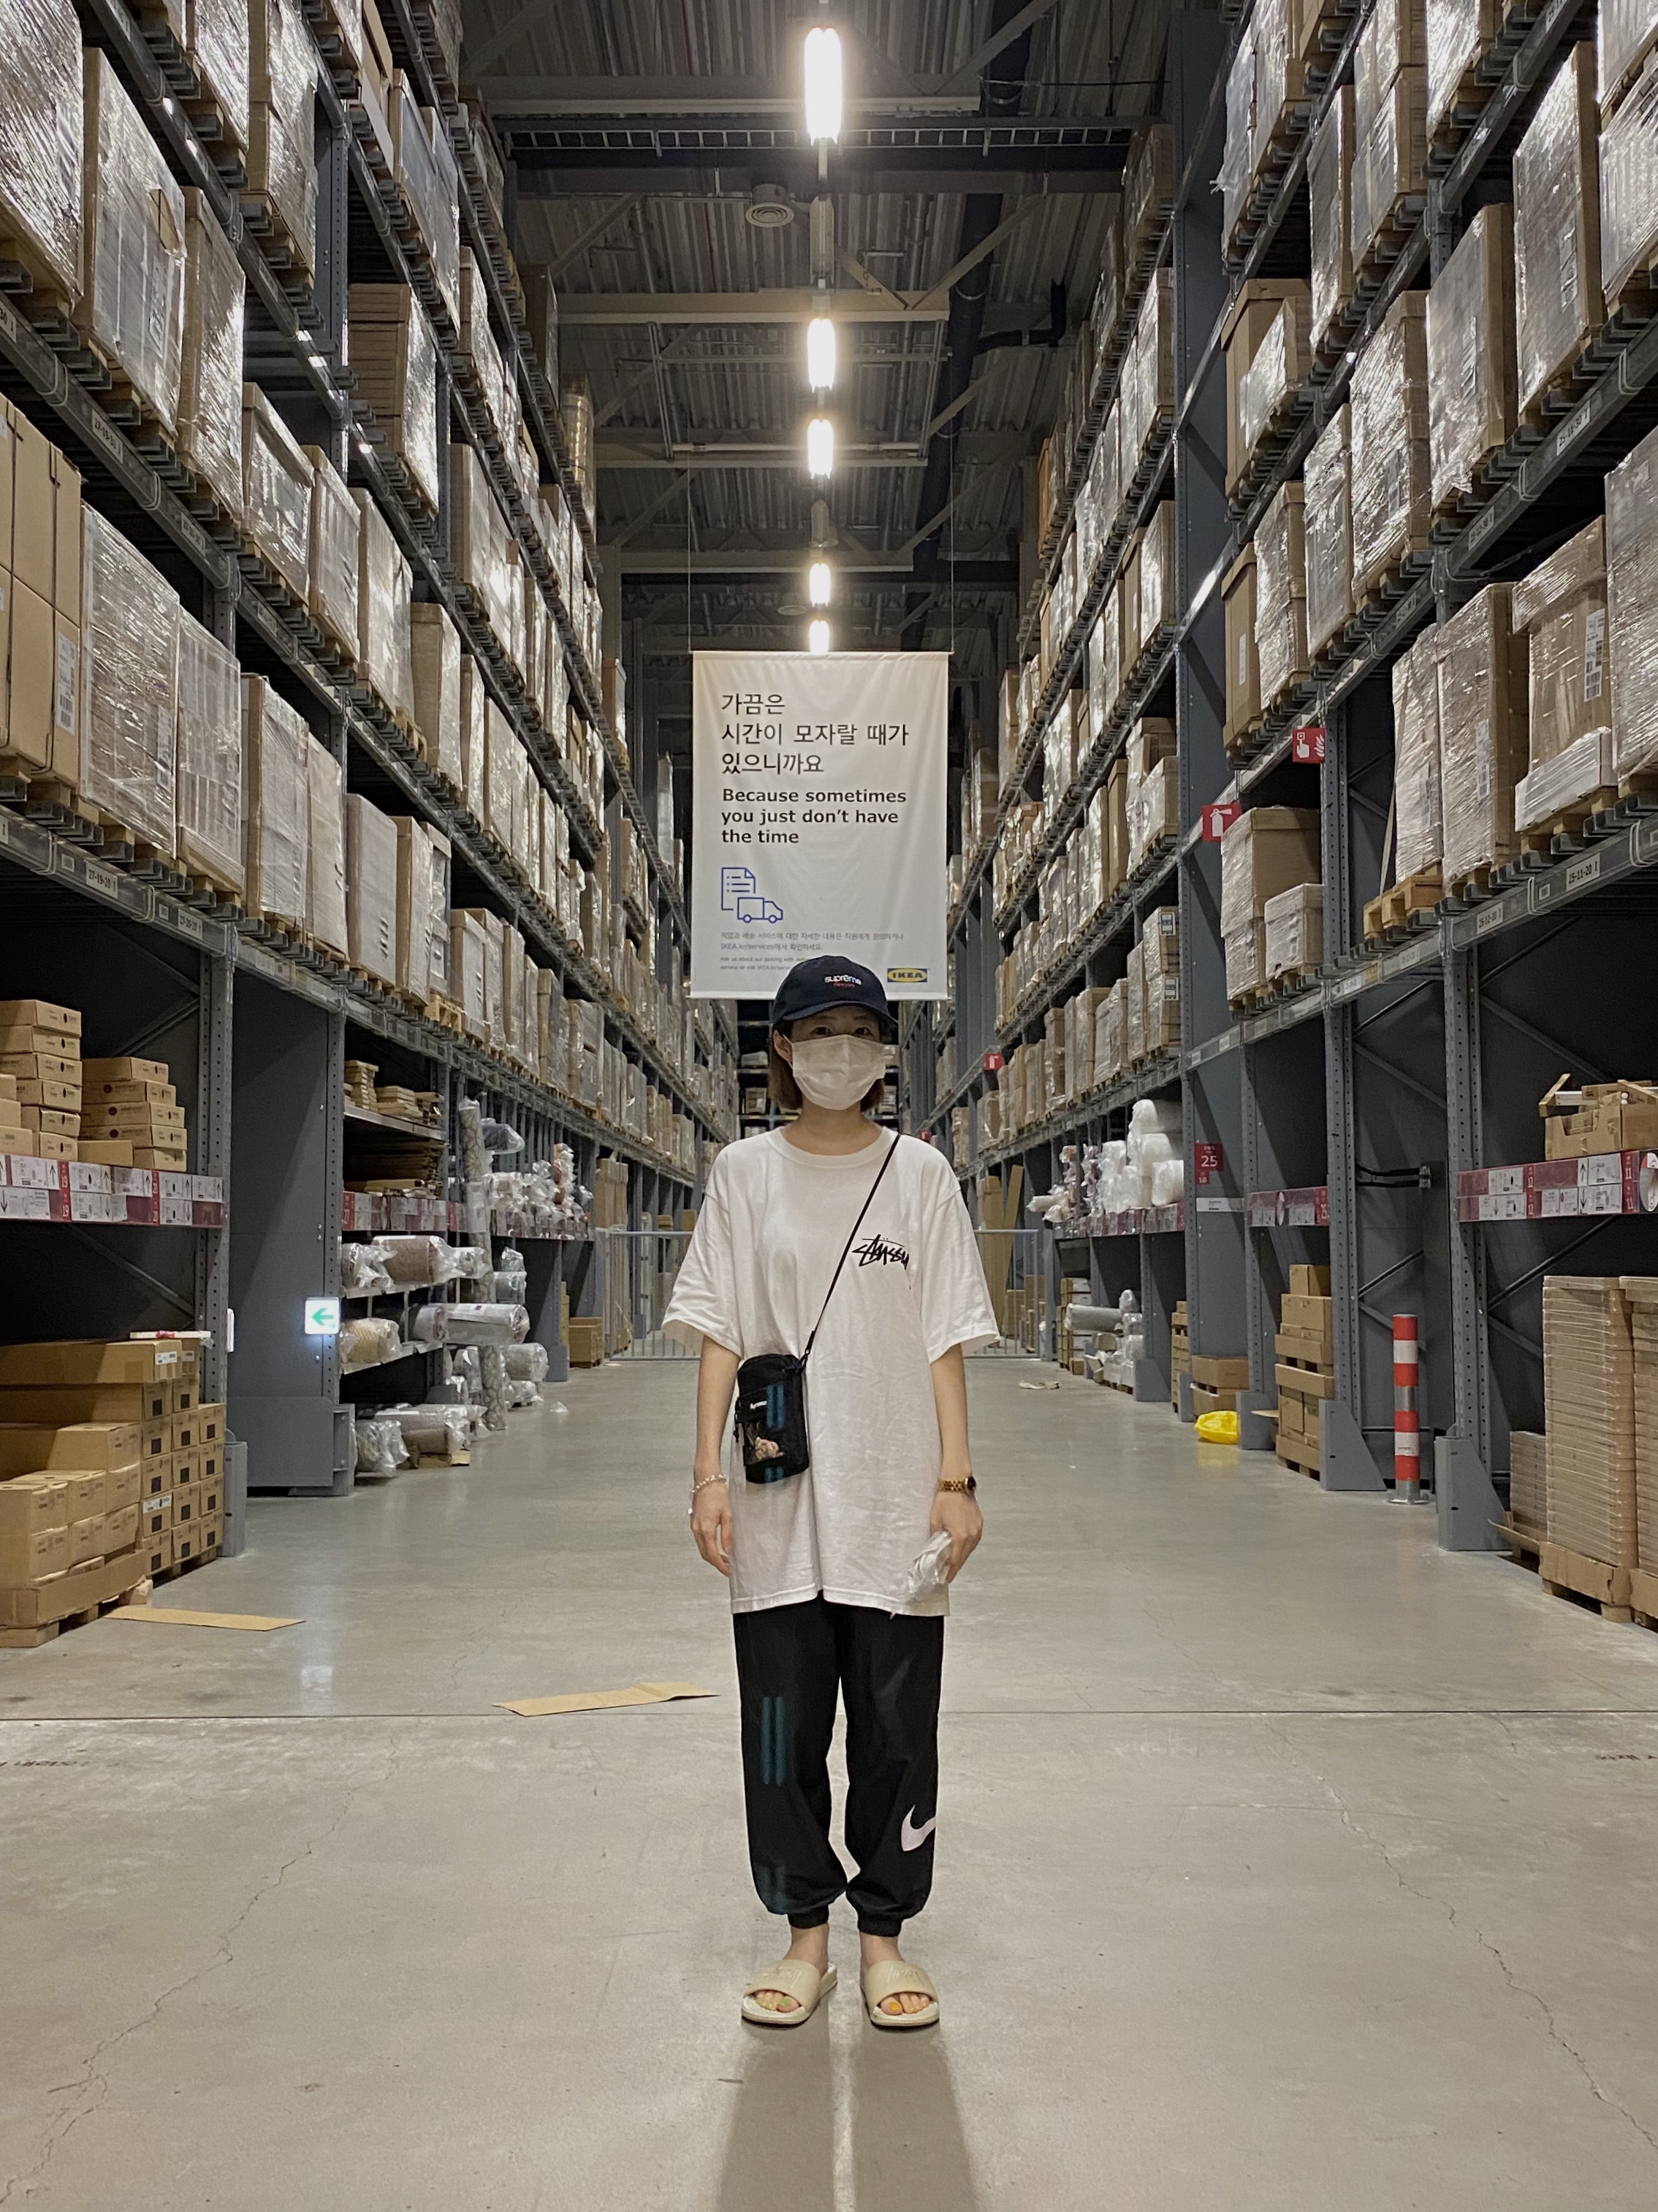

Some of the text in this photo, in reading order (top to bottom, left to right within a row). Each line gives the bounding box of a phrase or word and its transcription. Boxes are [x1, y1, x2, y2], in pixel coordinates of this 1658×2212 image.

[721, 693, 786, 715] 가끔은
[721, 723, 909, 746] 시간이 모자랄 때가
[722, 752, 824, 774] 있으니까요
[723, 788, 907, 802] Because sometimes
[721, 812, 753, 825] you
[759, 809, 796, 825] just
[856, 809, 899, 823] have
[722, 830, 799, 843] the time
[88, 869, 111, 889] 27-19-20
[1201, 1155, 1218, 1167] 25
